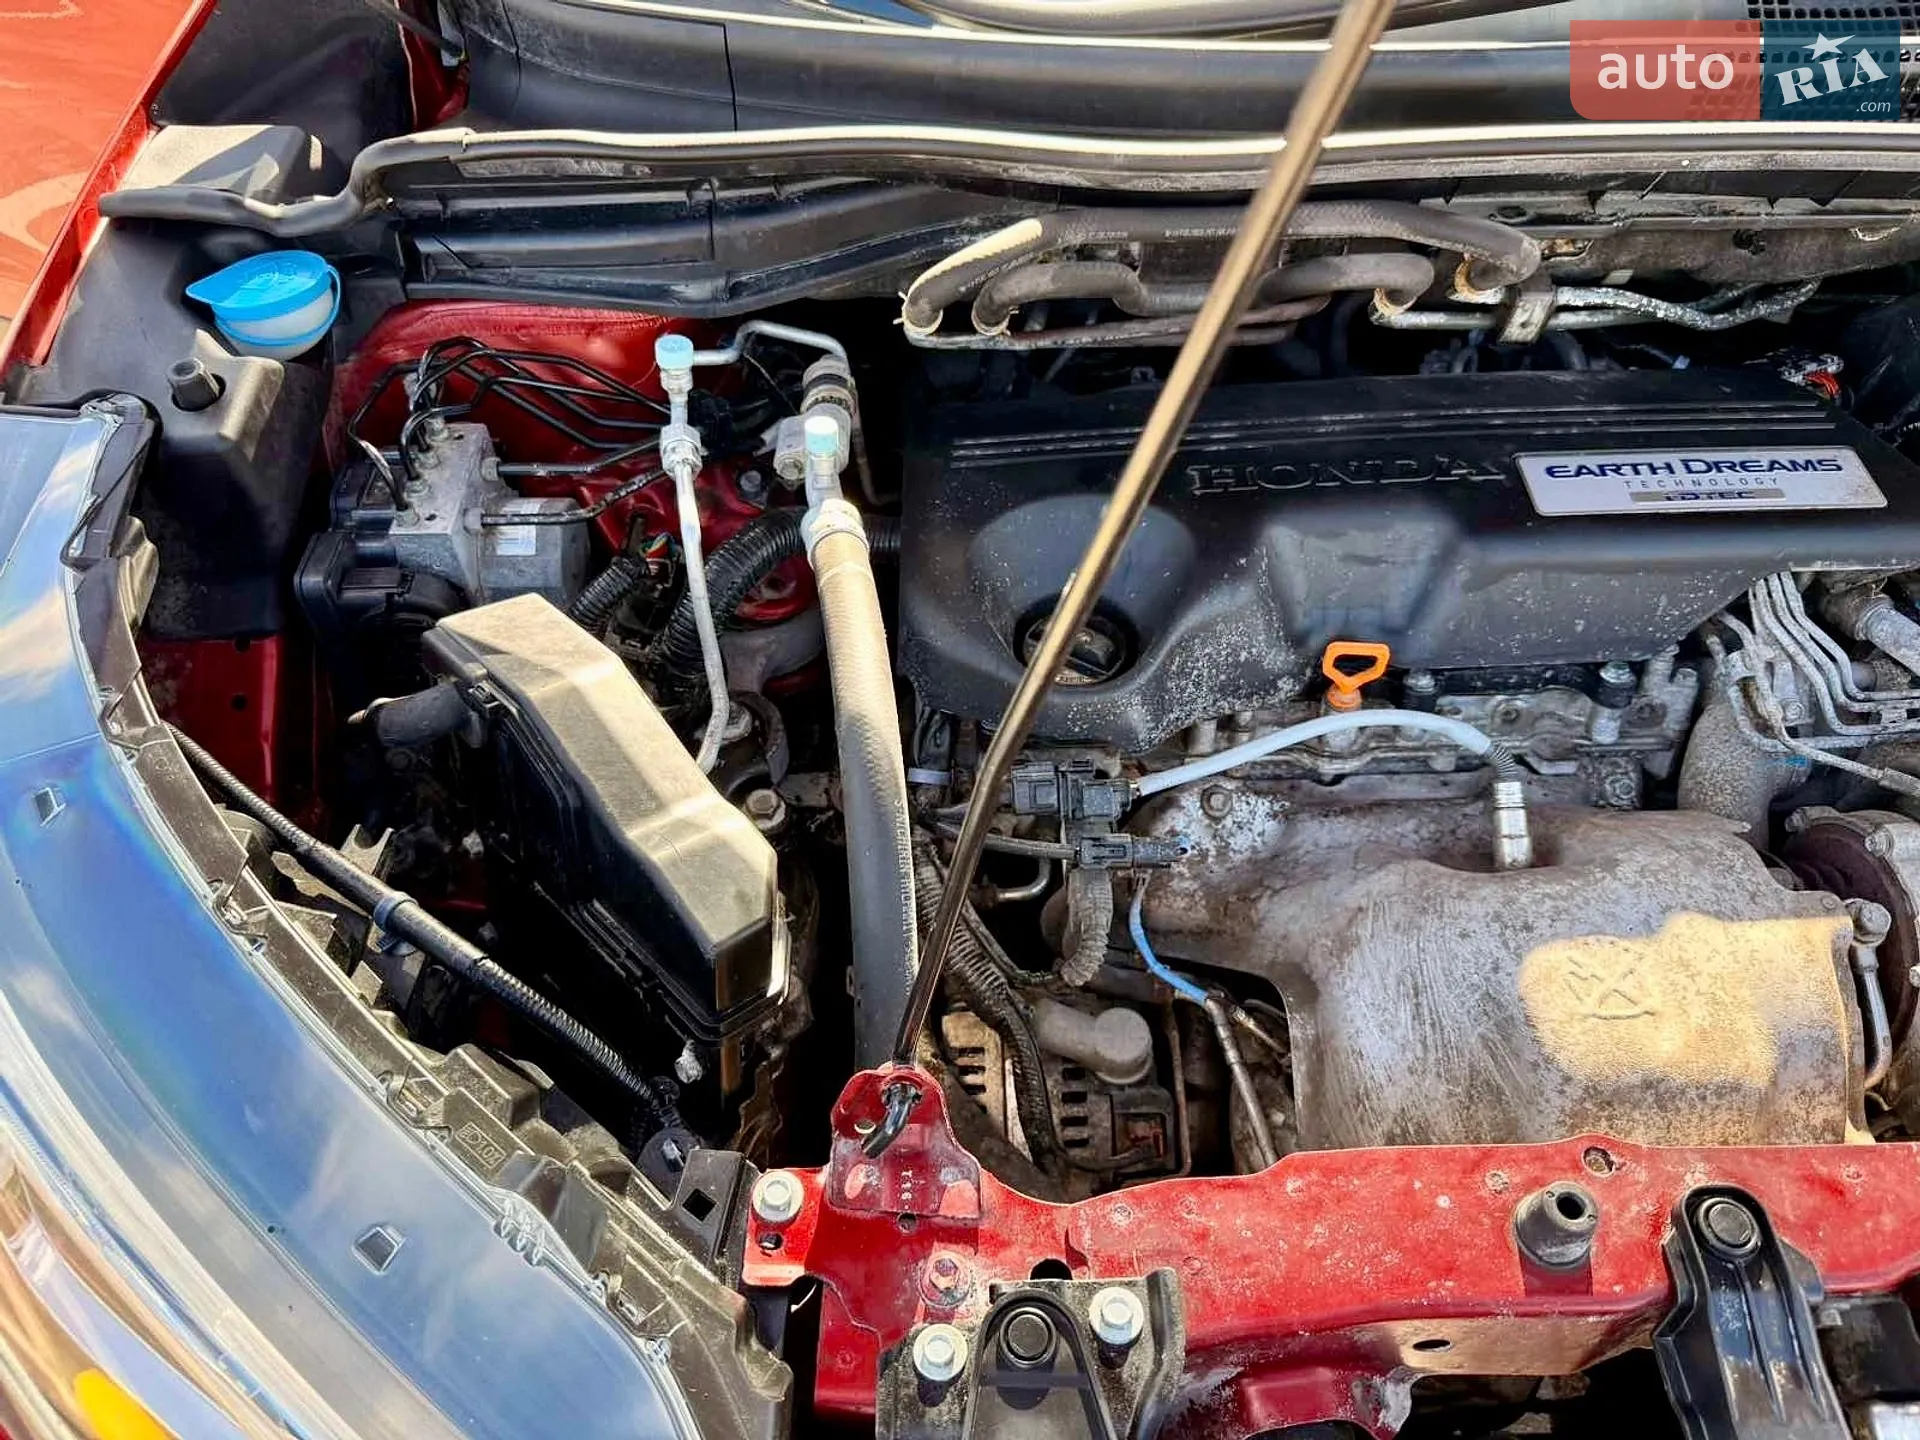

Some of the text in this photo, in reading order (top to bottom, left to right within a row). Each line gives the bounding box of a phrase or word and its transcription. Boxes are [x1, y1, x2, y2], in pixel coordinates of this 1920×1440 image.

[1186, 454, 1506, 495] HONDA
[1545, 458, 1844, 479] EARTH DREAMS
[1623, 476, 1780, 490] TECHNOLOGY
